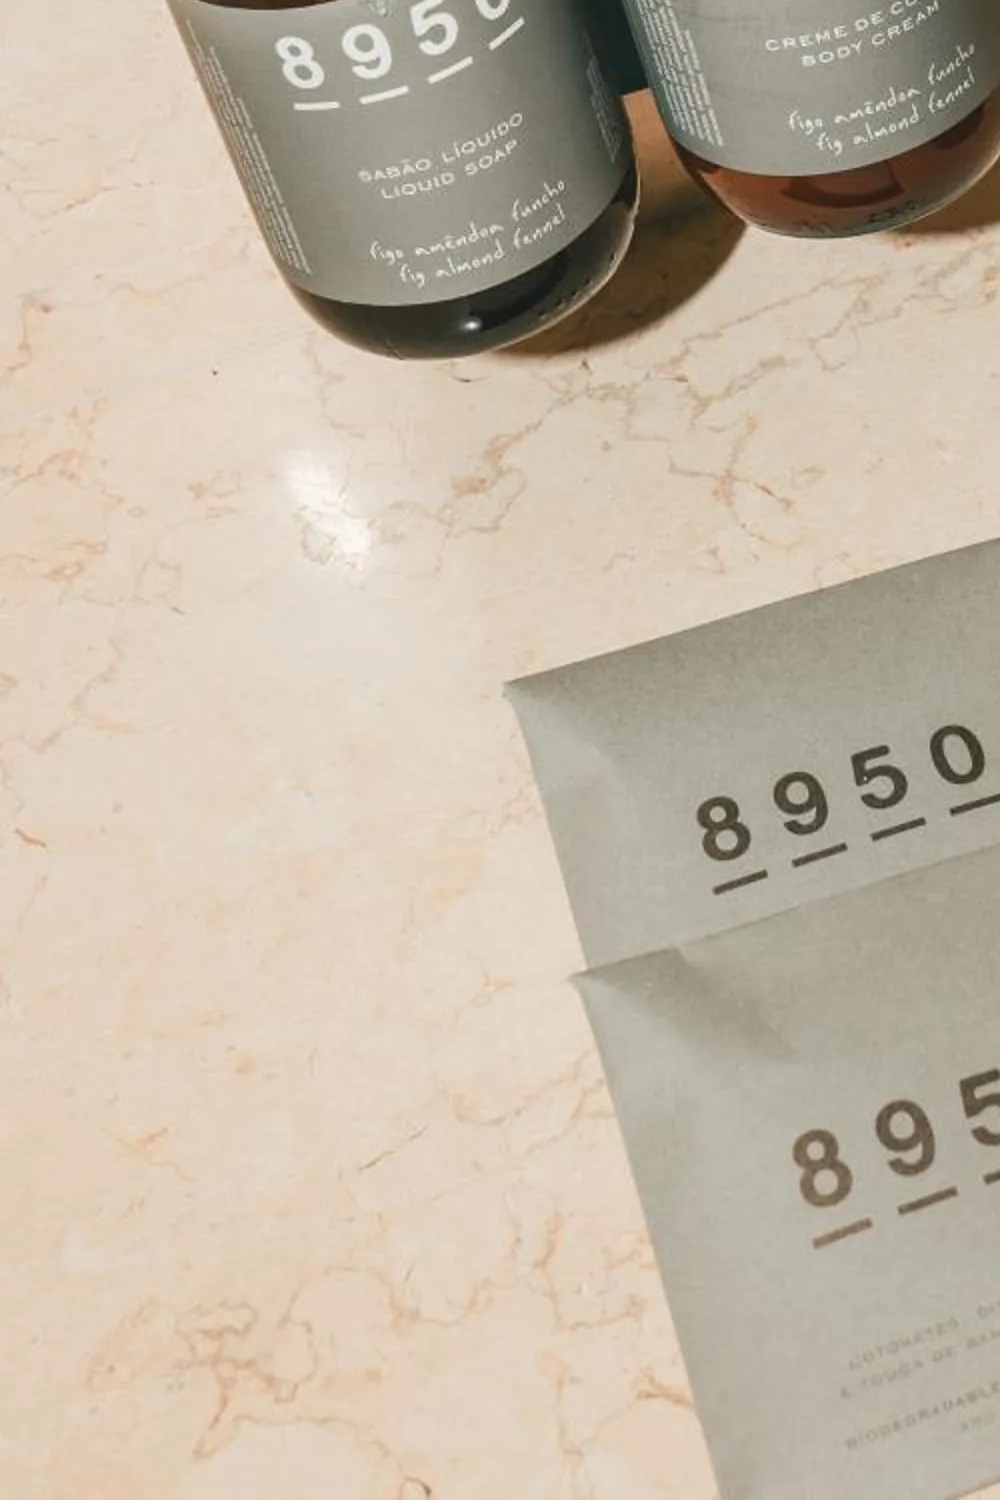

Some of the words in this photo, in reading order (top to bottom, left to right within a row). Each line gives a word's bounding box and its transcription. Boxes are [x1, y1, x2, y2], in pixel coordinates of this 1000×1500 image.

[765, 25, 848, 51] CREME
[855, 11, 884, 31] DE
[801, 40, 862, 67] BODY
[871, 0, 939, 45] CREAM
[927, 43, 975, 85] funcho
[817, 132, 843, 156] fig
[853, 104, 920, 145] almond
[928, 66, 975, 113] fennel
[358, 158, 431, 183] SABÃO
[381, 172, 455, 199] LIQUID
[464, 139, 518, 176] SOAP
[370, 240, 404, 266] figo
[511, 180, 565, 222] funcho
[400, 263, 425, 289] fig
[435, 238, 505, 278] almond
[513, 203, 566, 250] fennel
[696, 724, 986, 862] 8950
